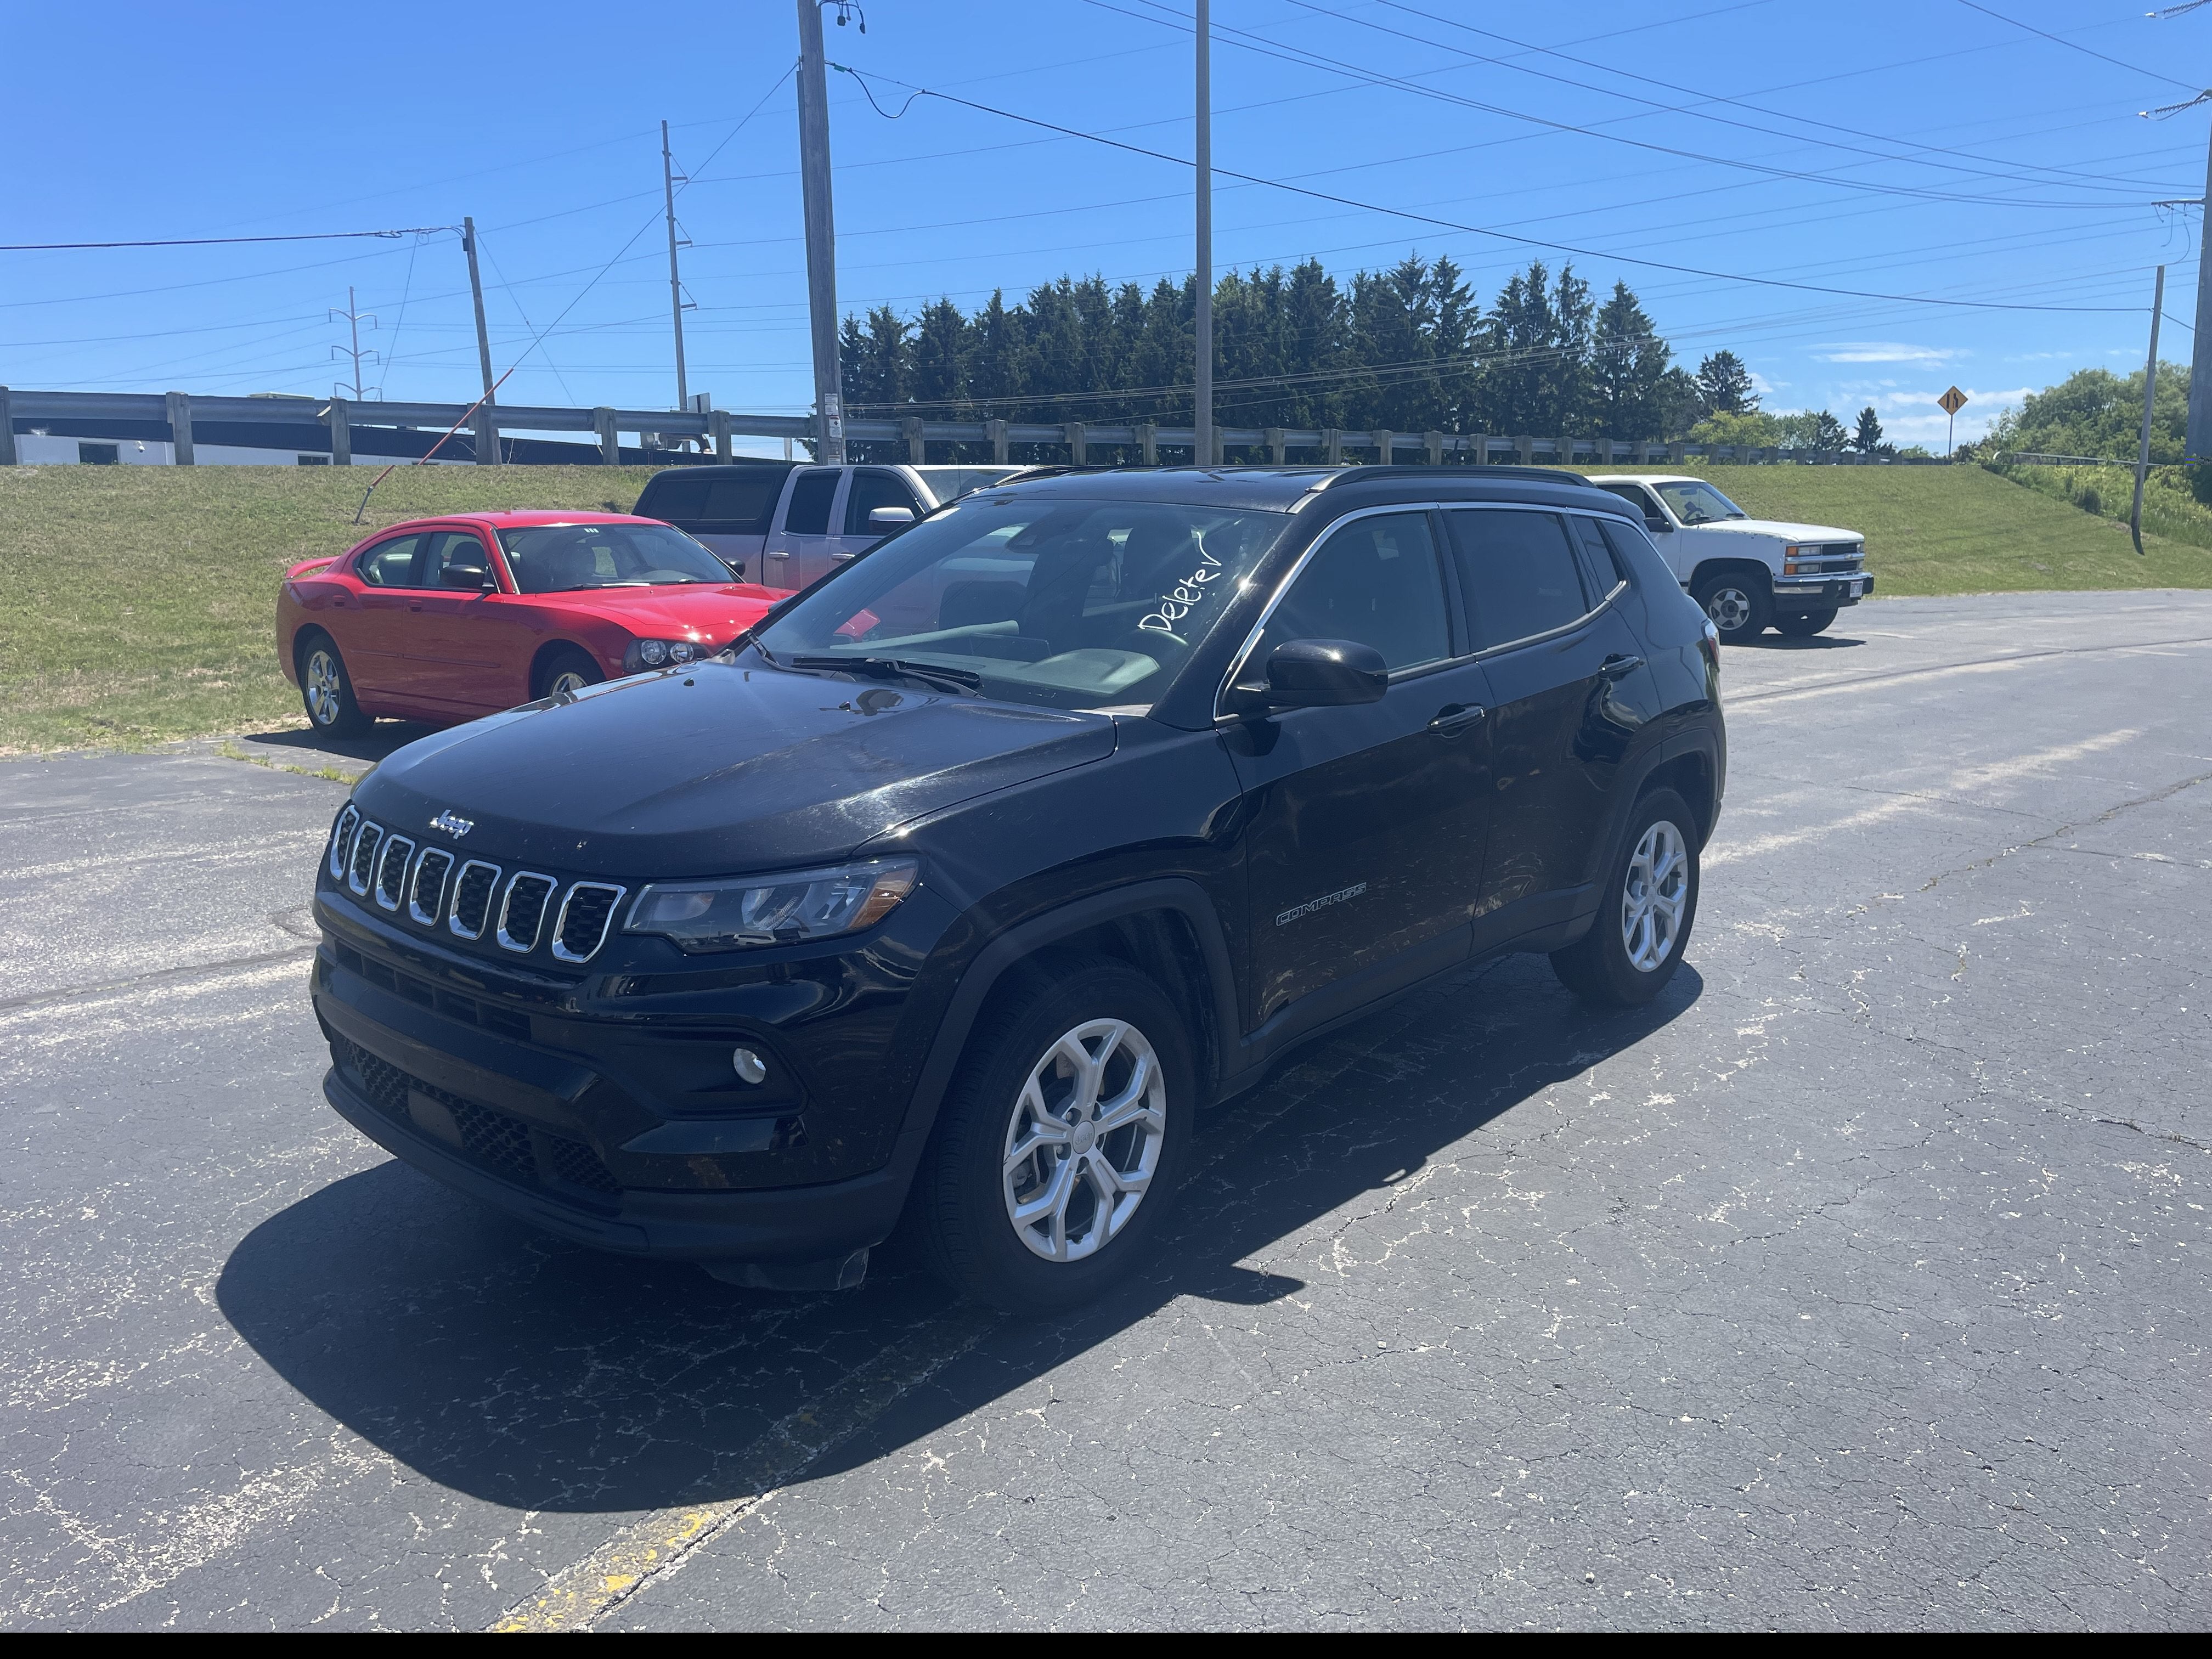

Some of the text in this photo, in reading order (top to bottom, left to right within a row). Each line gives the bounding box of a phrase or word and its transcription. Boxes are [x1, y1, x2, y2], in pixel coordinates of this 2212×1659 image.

[430, 809, 475, 840] Jeep
[1276, 882, 1367, 927] COMPASS
[1075, 1131, 1093, 1146] Jeep
